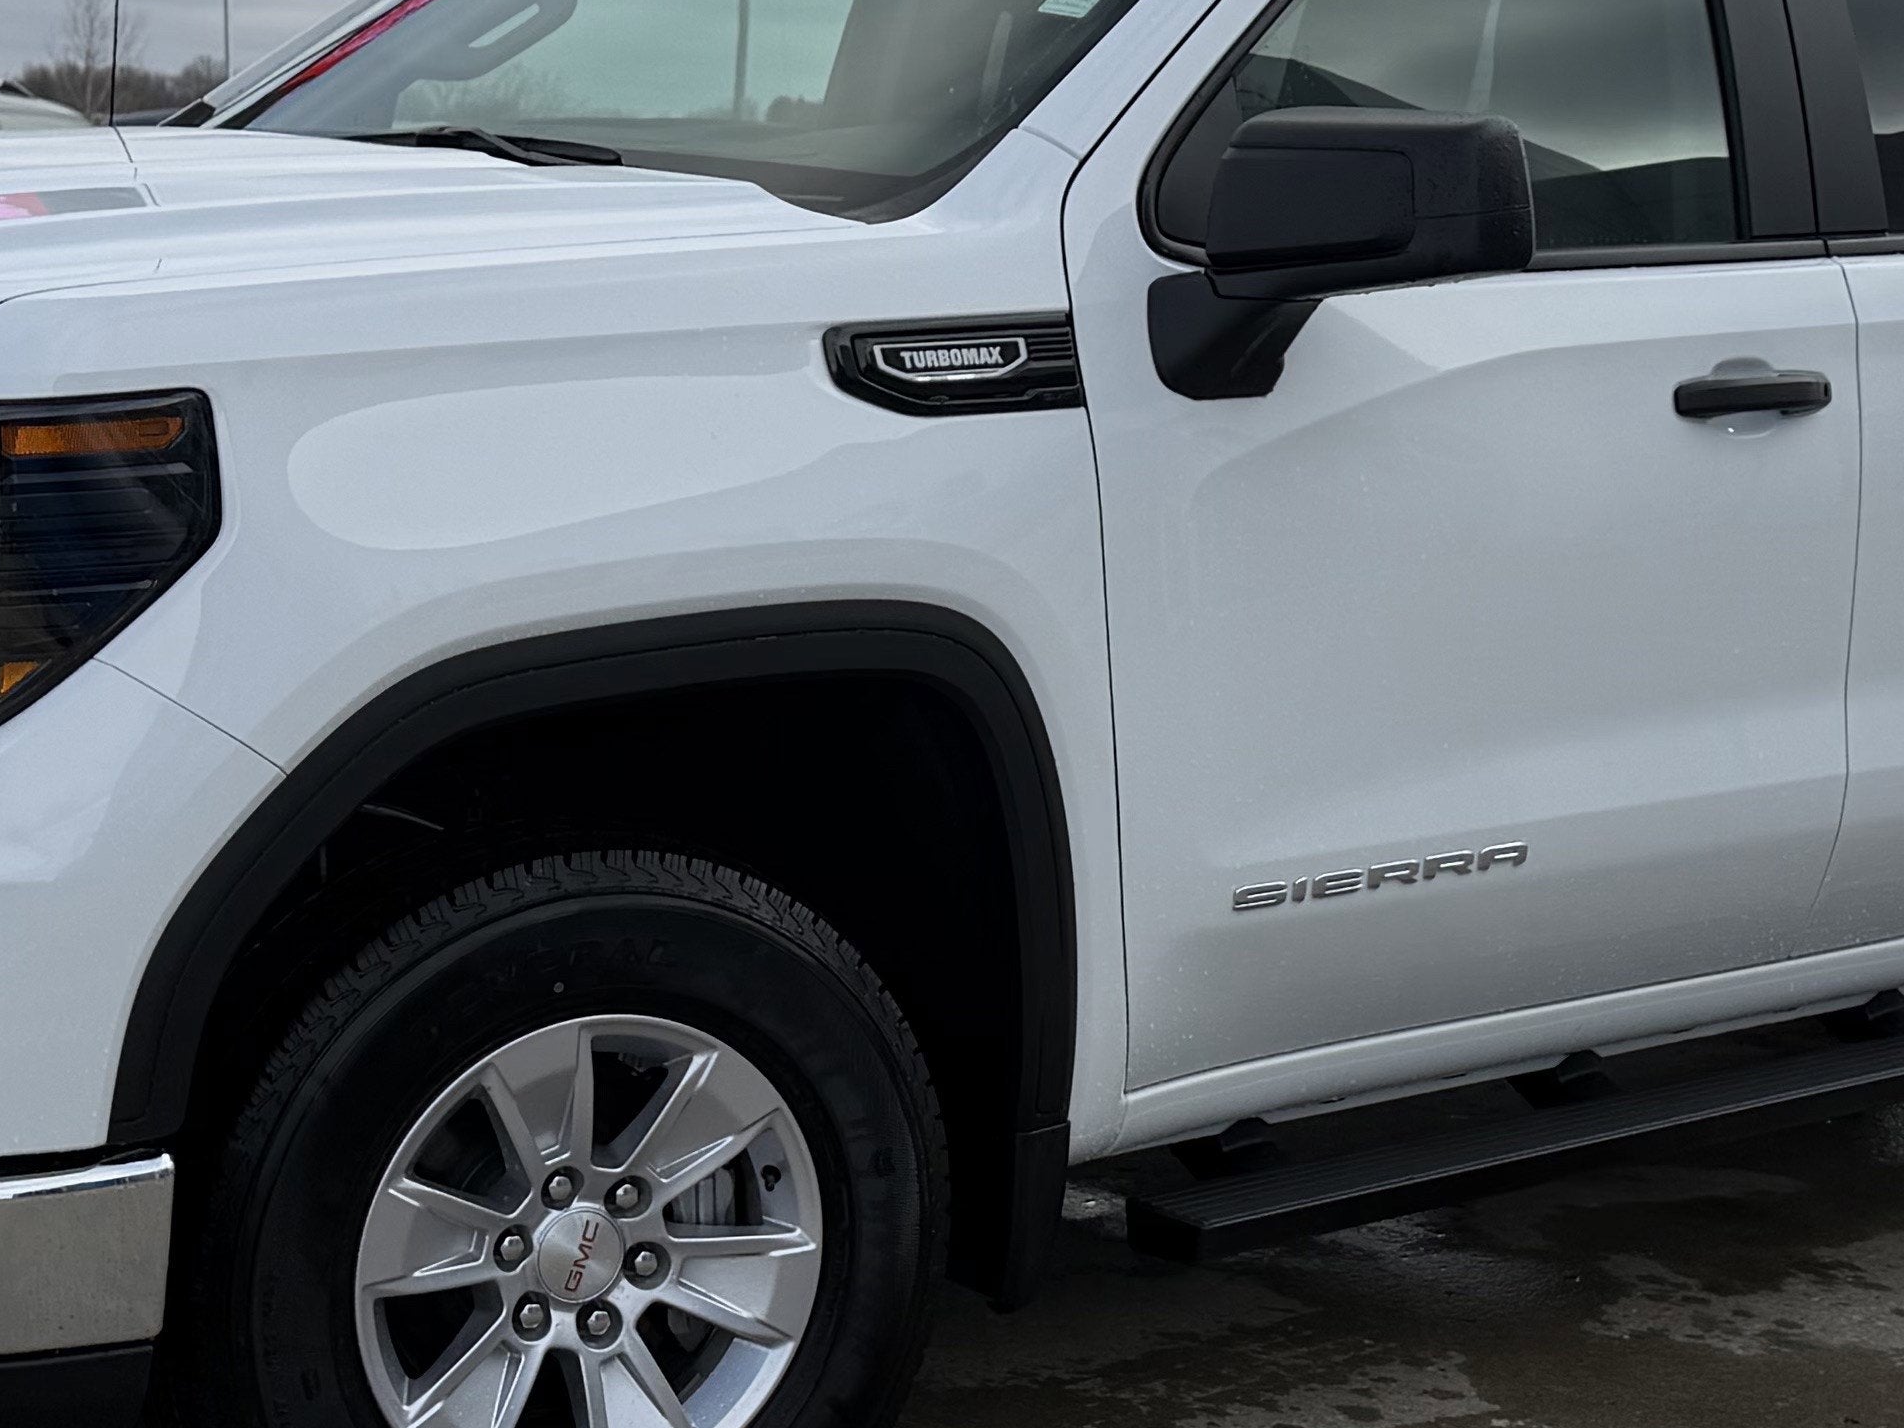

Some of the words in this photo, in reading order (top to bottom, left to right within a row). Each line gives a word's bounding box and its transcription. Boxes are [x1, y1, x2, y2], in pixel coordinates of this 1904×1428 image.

[900, 346, 1004, 369] TURBOMAX
[1232, 839, 1529, 912] SIERRA
[564, 1219, 600, 1292] GMC
